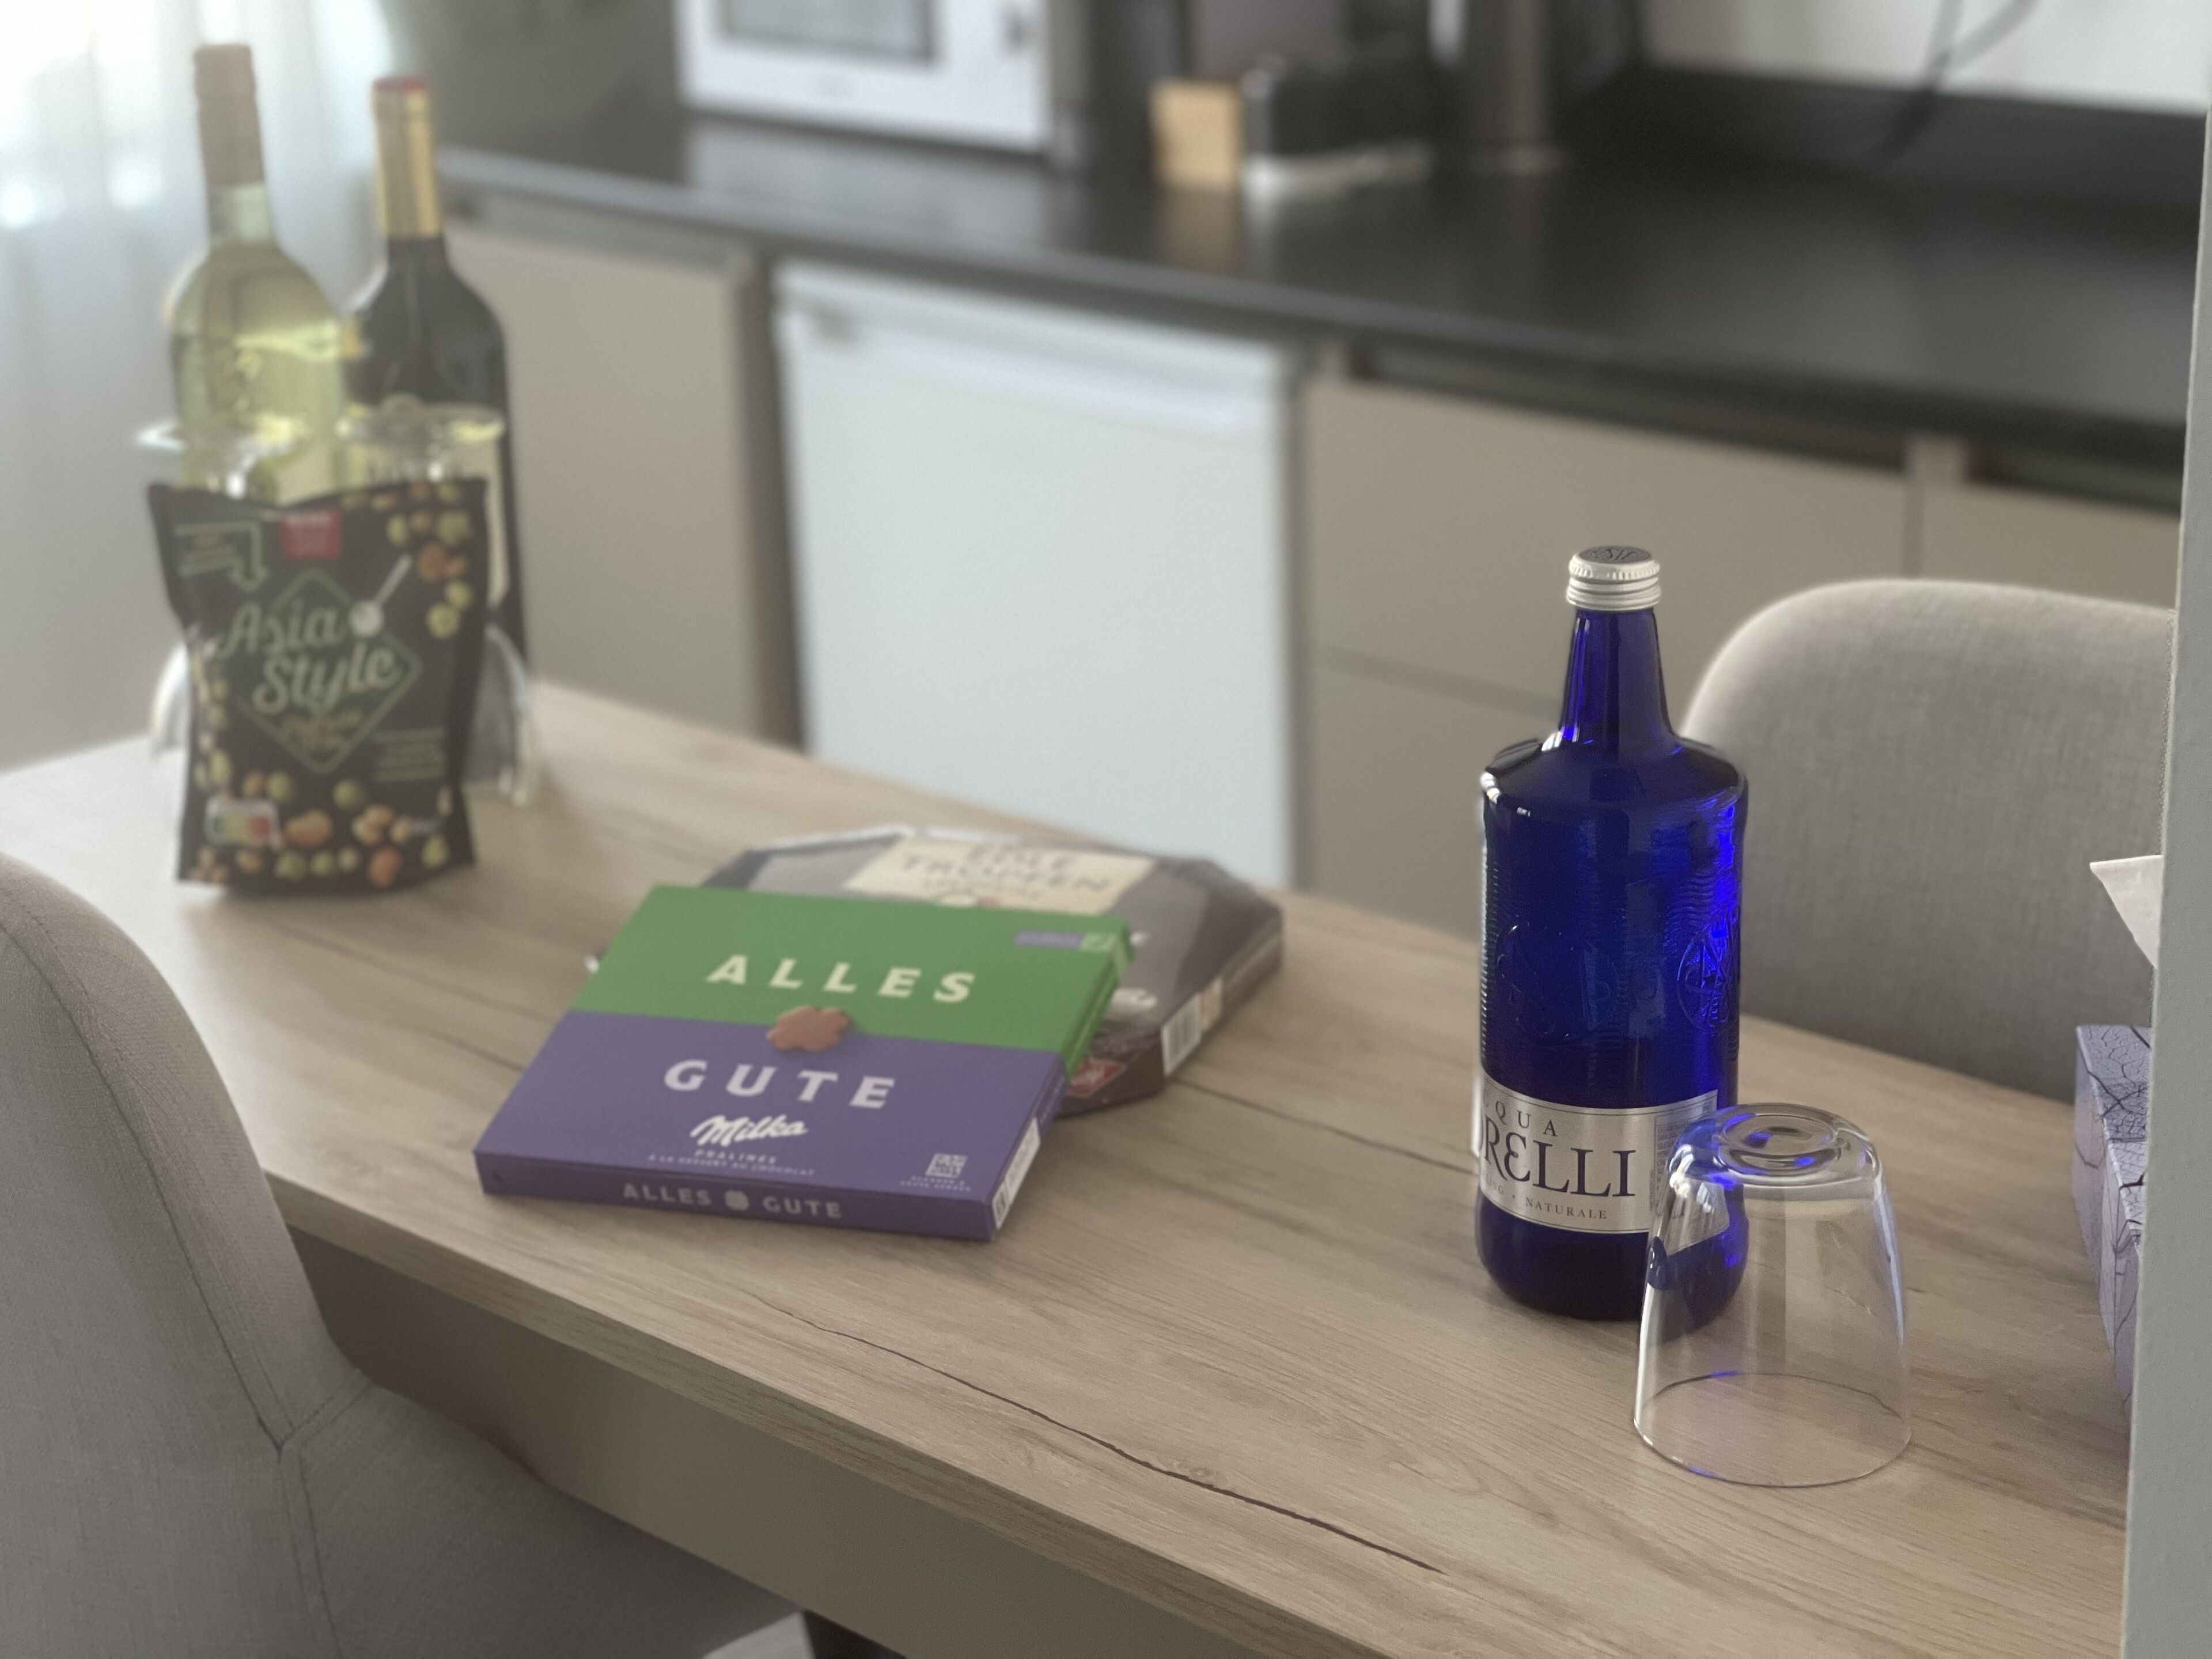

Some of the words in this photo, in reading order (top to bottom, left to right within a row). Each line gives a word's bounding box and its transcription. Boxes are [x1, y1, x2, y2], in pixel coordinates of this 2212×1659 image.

[214, 599, 343, 661] Asia
[252, 641, 400, 715] Style
[706, 954, 975, 1003] ALLES
[663, 1059, 896, 1109] GUTE
[690, 1114, 808, 1147] Milka
[1481, 1113, 1637, 1197] RELLI
[623, 1183, 712, 1206] ALLES
[762, 1196, 842, 1218] GUTE
[1526, 1196, 1607, 1219] NATURALE
